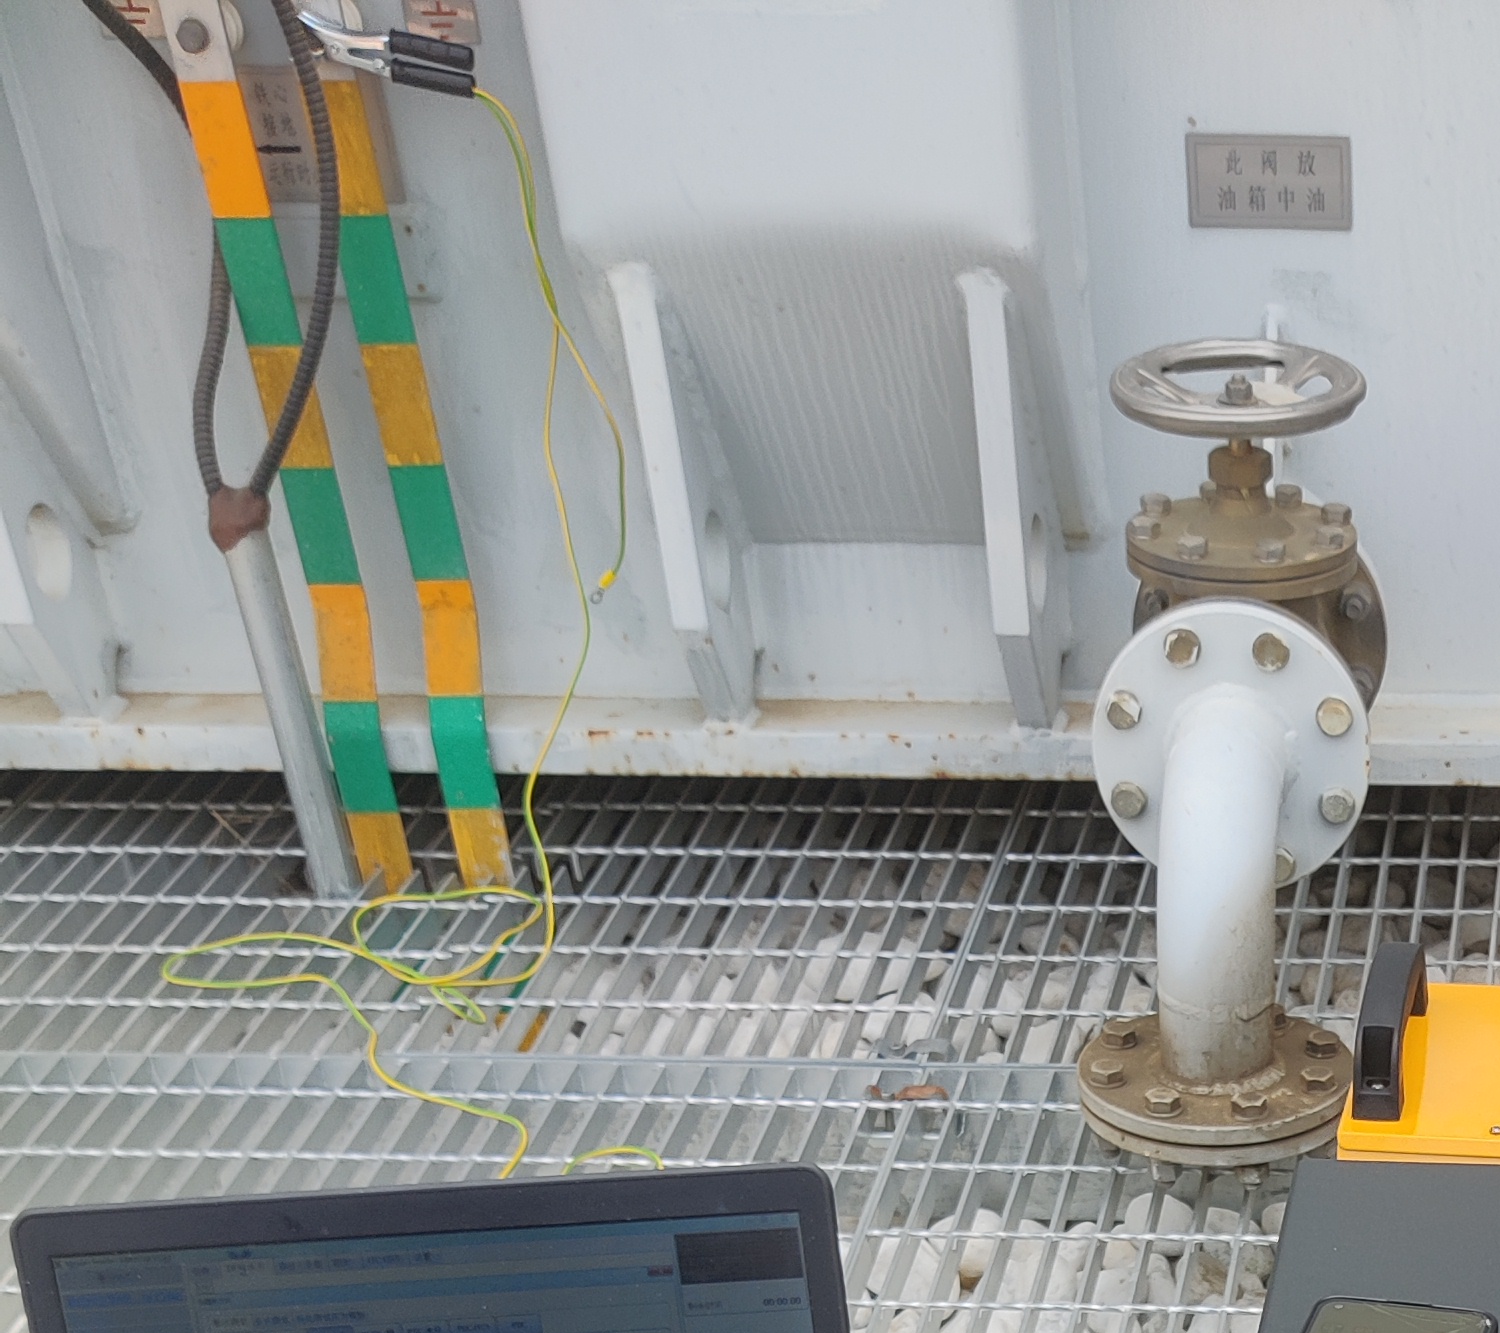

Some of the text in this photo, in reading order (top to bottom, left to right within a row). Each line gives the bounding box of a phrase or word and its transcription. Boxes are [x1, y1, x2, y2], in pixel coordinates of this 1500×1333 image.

[1225, 150, 1316, 177] 此阀放
[1217, 185, 1325, 212] 油箱中油
